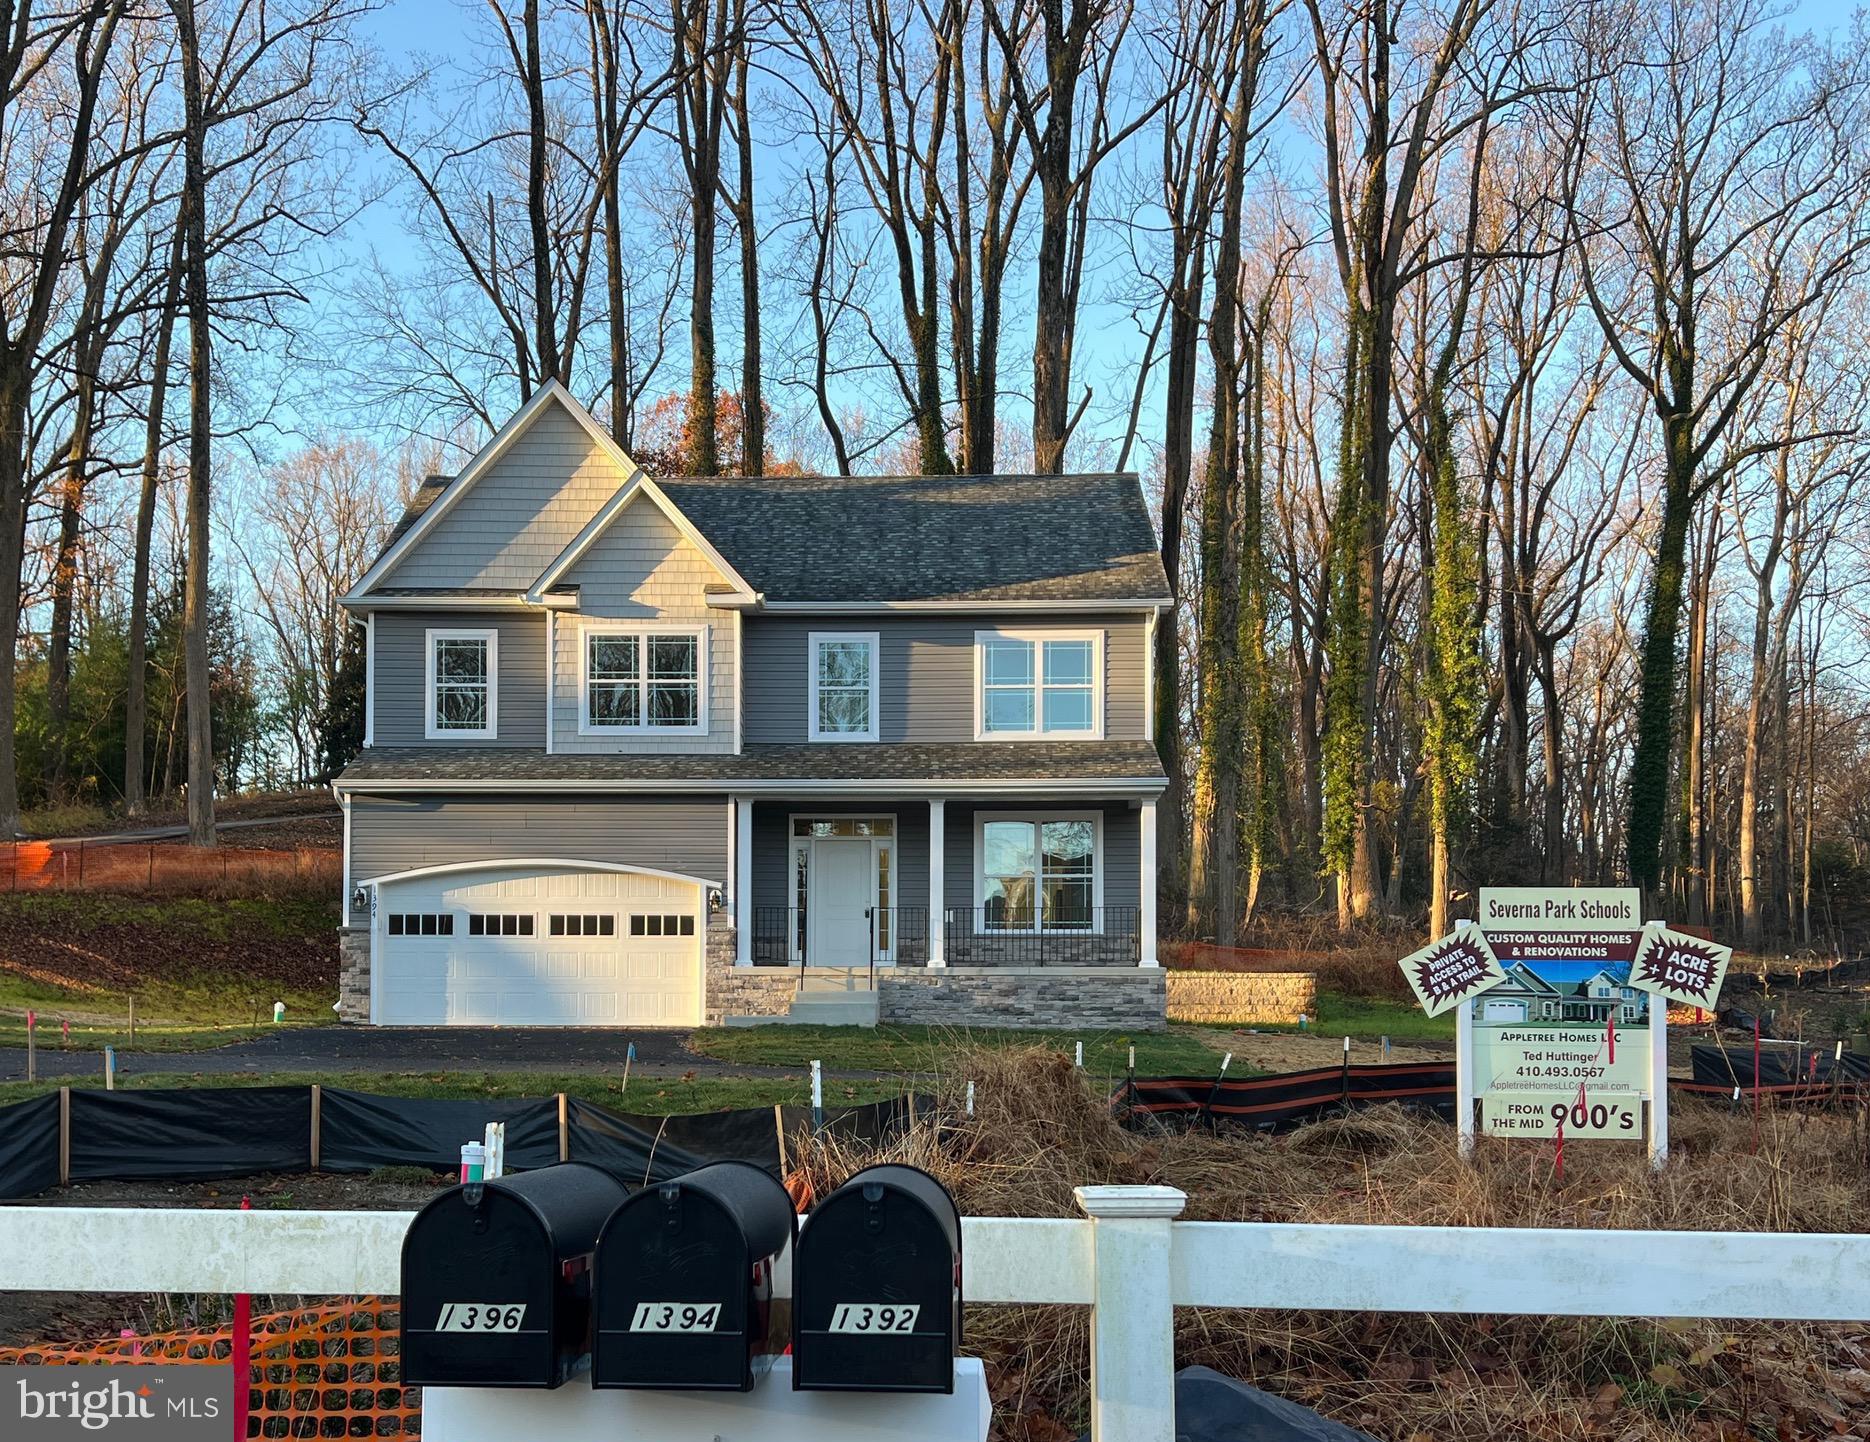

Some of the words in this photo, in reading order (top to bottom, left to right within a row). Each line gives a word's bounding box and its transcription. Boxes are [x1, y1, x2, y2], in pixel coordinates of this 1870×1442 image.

[1489, 899, 1540, 919] Severna
[1545, 899, 1576, 919] Park
[1580, 900, 1631, 919] Schools
[1487, 933, 1535, 944] CUSTOM
[1538, 934, 1588, 945] QUALITY
[1590, 934, 1632, 944] HOMES
[1428, 948, 1466, 973] PRIVATE
[1511, 946, 1521, 957] &
[1524, 946, 1608, 957] RENOVATIONS
[1657, 946, 1665, 959] 1
[1667, 950, 1710, 973] ACRE
[1429, 961, 1463, 986] ACCESS
[1462, 955, 1476, 968] TO
[1432, 985, 1442, 996] B
[1441, 981, 1451, 992] &
[1449, 977, 1459, 988] A
[1456, 965, 1483, 983] TRAIL
[1649, 964, 1660, 975] +
[1664, 966, 1706, 989] LOTS
[1500, 1031, 1555, 1043] APPLETREE
[1559, 1032, 1597, 1043] HOMES
[1601, 1033, 1622, 1043] LC
[1523, 1051, 1542, 1061] Ted
[1546, 1051, 1598, 1064] Huttinger
[1516, 1066, 1605, 1078] 410.493.0567
[1508, 1104, 1544, 1115] FROM
[1551, 1103, 1634, 1130] 900's
[1492, 1118, 1516, 1129] THE
[1519, 1118, 1544, 1129] MID
[441, 1304, 521, 1330] 1396
[639, 1306, 715, 1330] 1394
[838, 1307, 914, 1331] 1392
